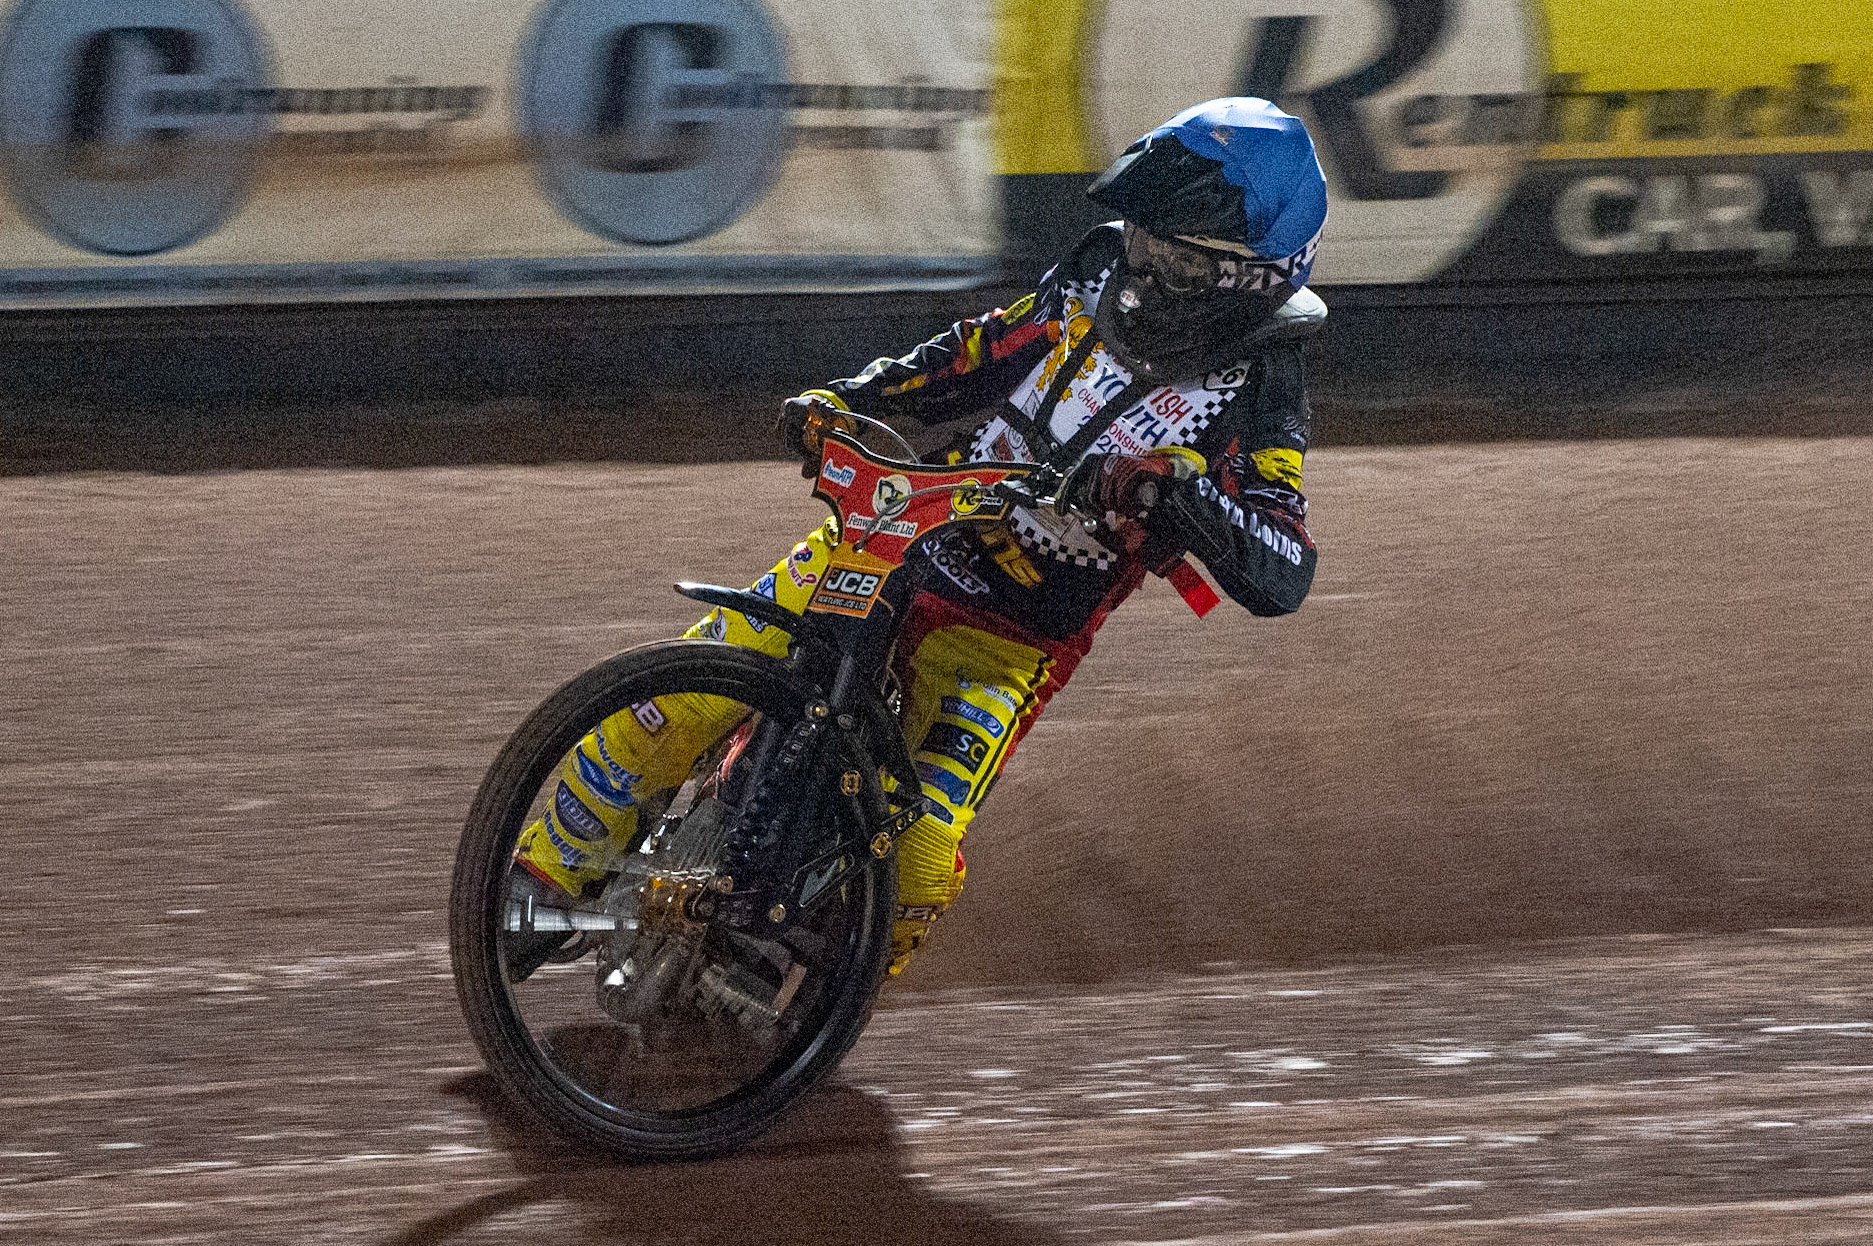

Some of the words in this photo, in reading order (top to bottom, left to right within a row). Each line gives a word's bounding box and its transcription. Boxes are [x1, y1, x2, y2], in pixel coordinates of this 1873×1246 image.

[1149, 387, 1195, 426] ISH
[847, 514, 877, 532] Fenwy
[825, 570, 880, 597] JCB
